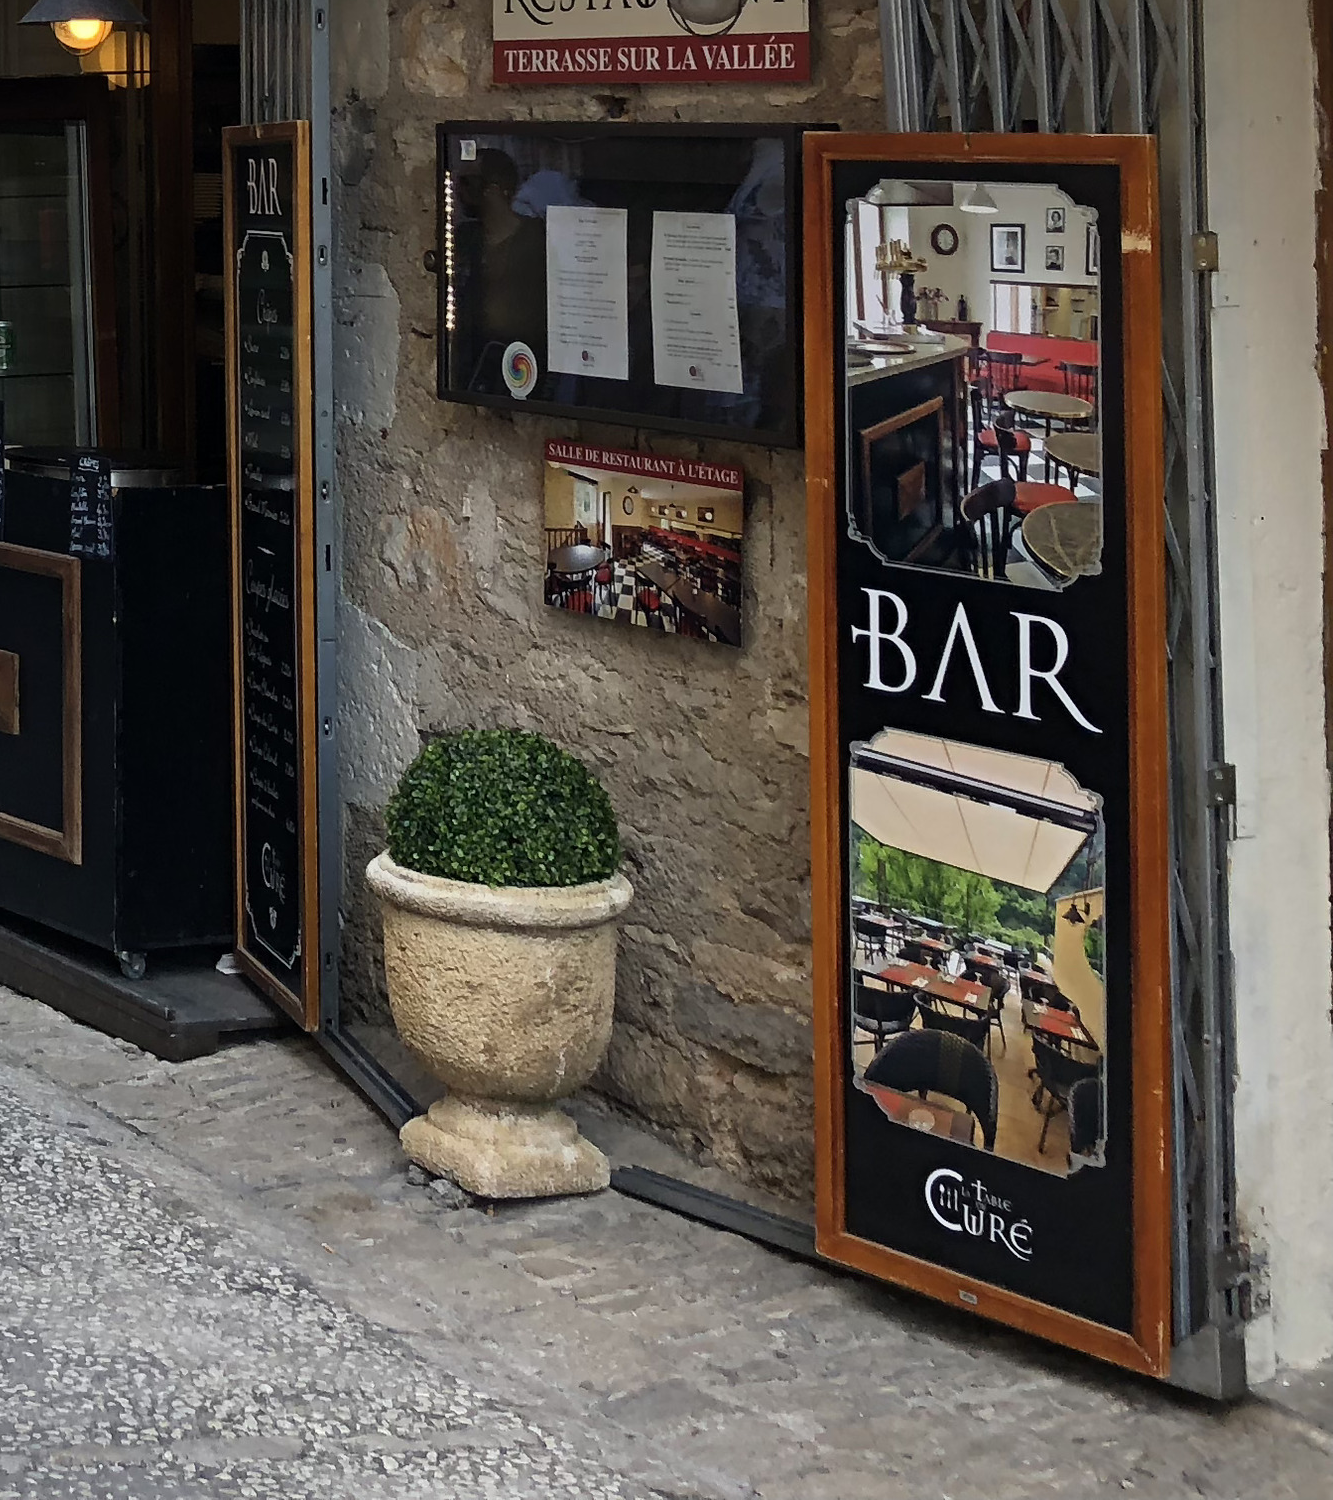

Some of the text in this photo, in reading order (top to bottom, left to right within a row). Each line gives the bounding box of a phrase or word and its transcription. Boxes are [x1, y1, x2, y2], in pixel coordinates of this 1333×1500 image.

[504, 36, 796, 73] TERRASSE SUR LA VALLÉE
[247, 158, 282, 216] BAR
[548, 443, 739, 485] SALLE DE RESTAURANT À L'ÉTAGE
[851, 587, 1103, 733] BAR
[925, 1168, 1033, 1262] CURÉ
[971, 1179, 1014, 1212] TABLE
